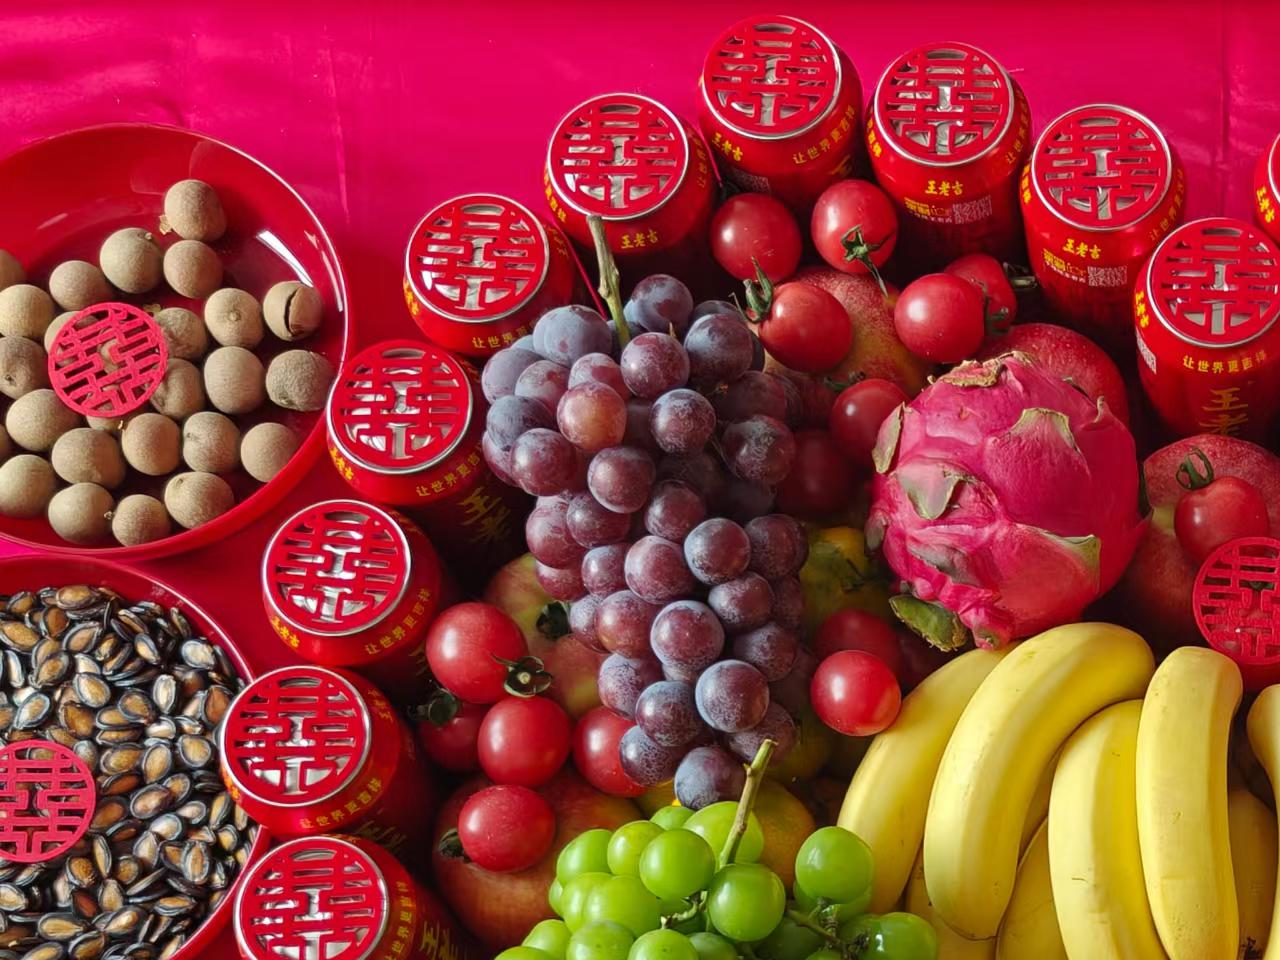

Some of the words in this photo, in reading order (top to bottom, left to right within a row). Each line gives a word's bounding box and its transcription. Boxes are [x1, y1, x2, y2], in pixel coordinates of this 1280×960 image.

[712, 132, 743, 161] 王老吉
[924, 179, 963, 196] 王老吉
[620, 228, 659, 250] 王老吉
[1061, 238, 1101, 259] 王老吉
[1182, 351, 1267, 374] 让世界更吉祥
[269, 614, 299, 648] 王老吉
